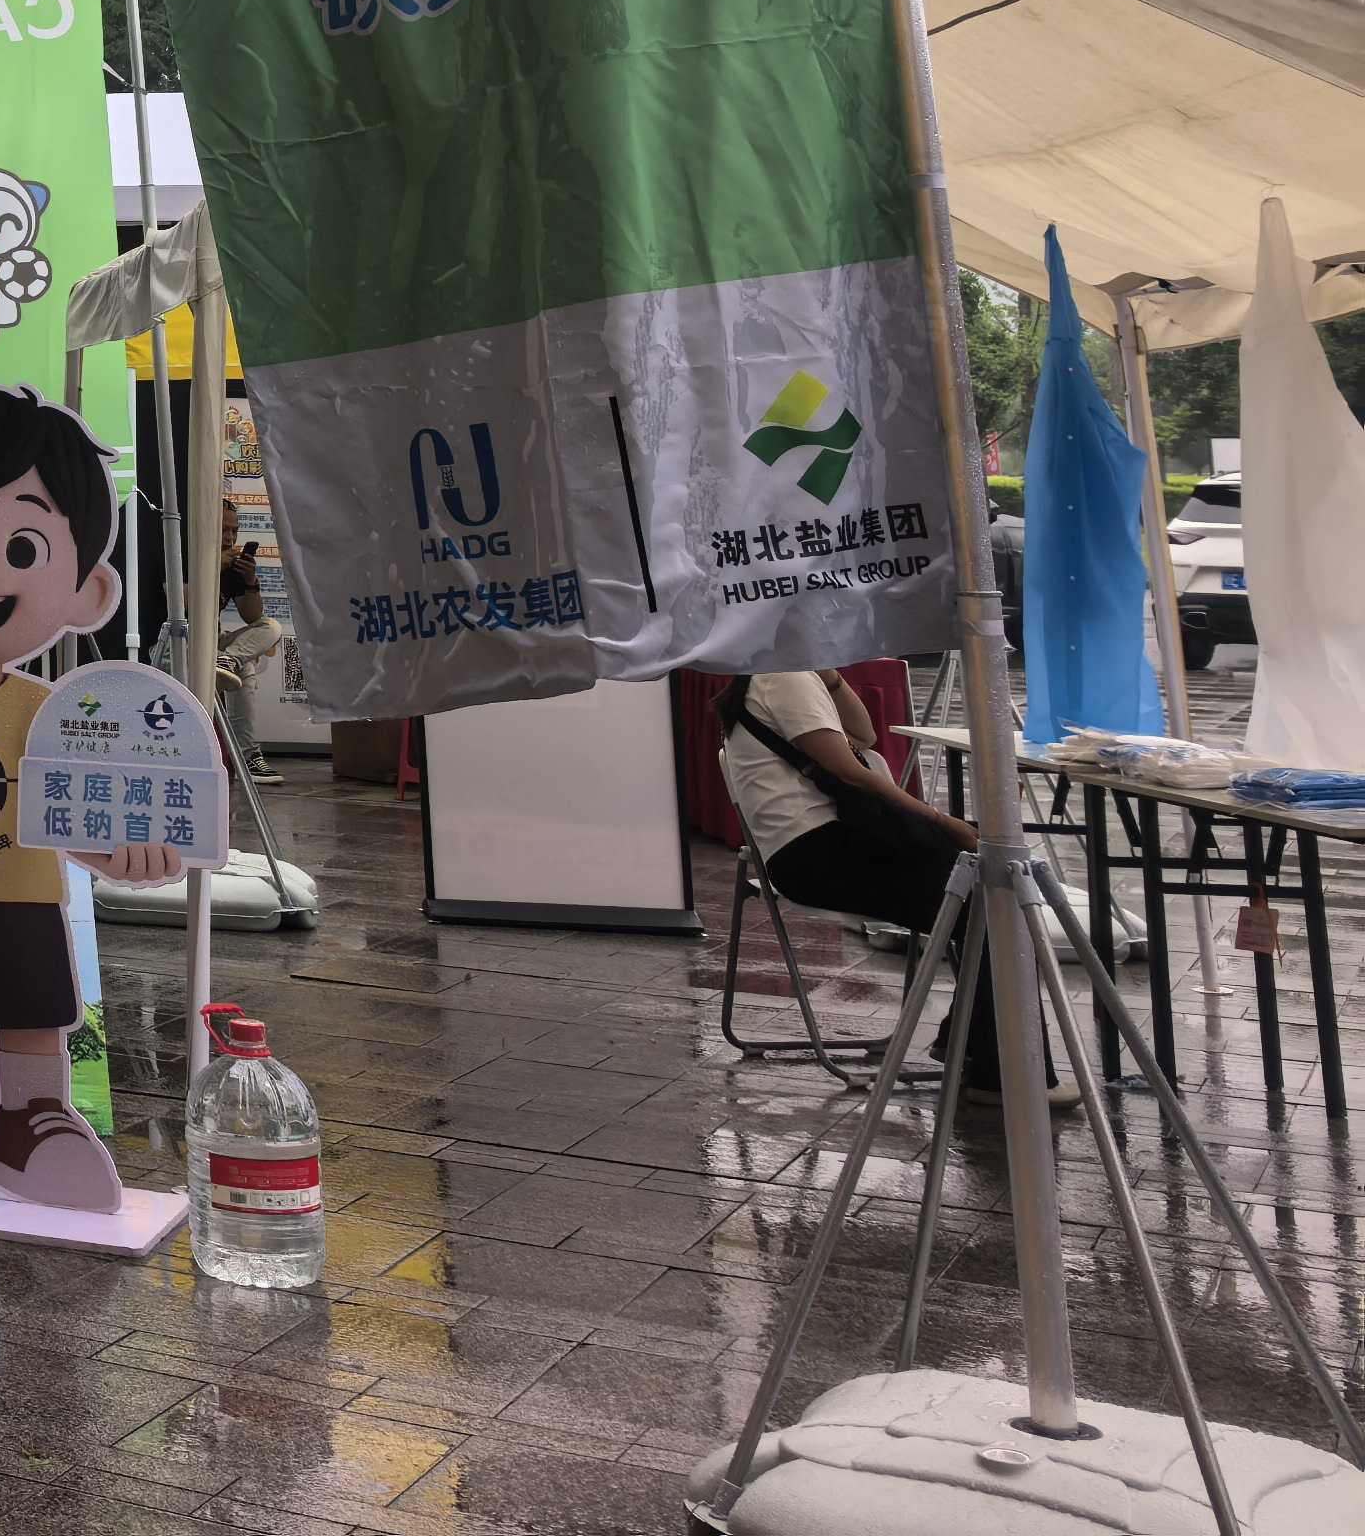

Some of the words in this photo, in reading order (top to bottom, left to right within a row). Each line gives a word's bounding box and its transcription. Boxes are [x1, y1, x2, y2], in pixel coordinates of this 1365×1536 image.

[420, 530, 511, 564] HADG
[711, 502, 929, 569] 湖北盐业集团
[722, 576, 800, 606] HUBEI
[806, 566, 854, 594] SALT
[856, 554, 932, 587] GROUP
[349, 568, 585, 646] 湖北农发集团
[60, 719, 120, 732] 湖北盐业集团
[43, 770, 194, 809] 家庭减盐
[42, 805, 195, 846] 低钠首选
